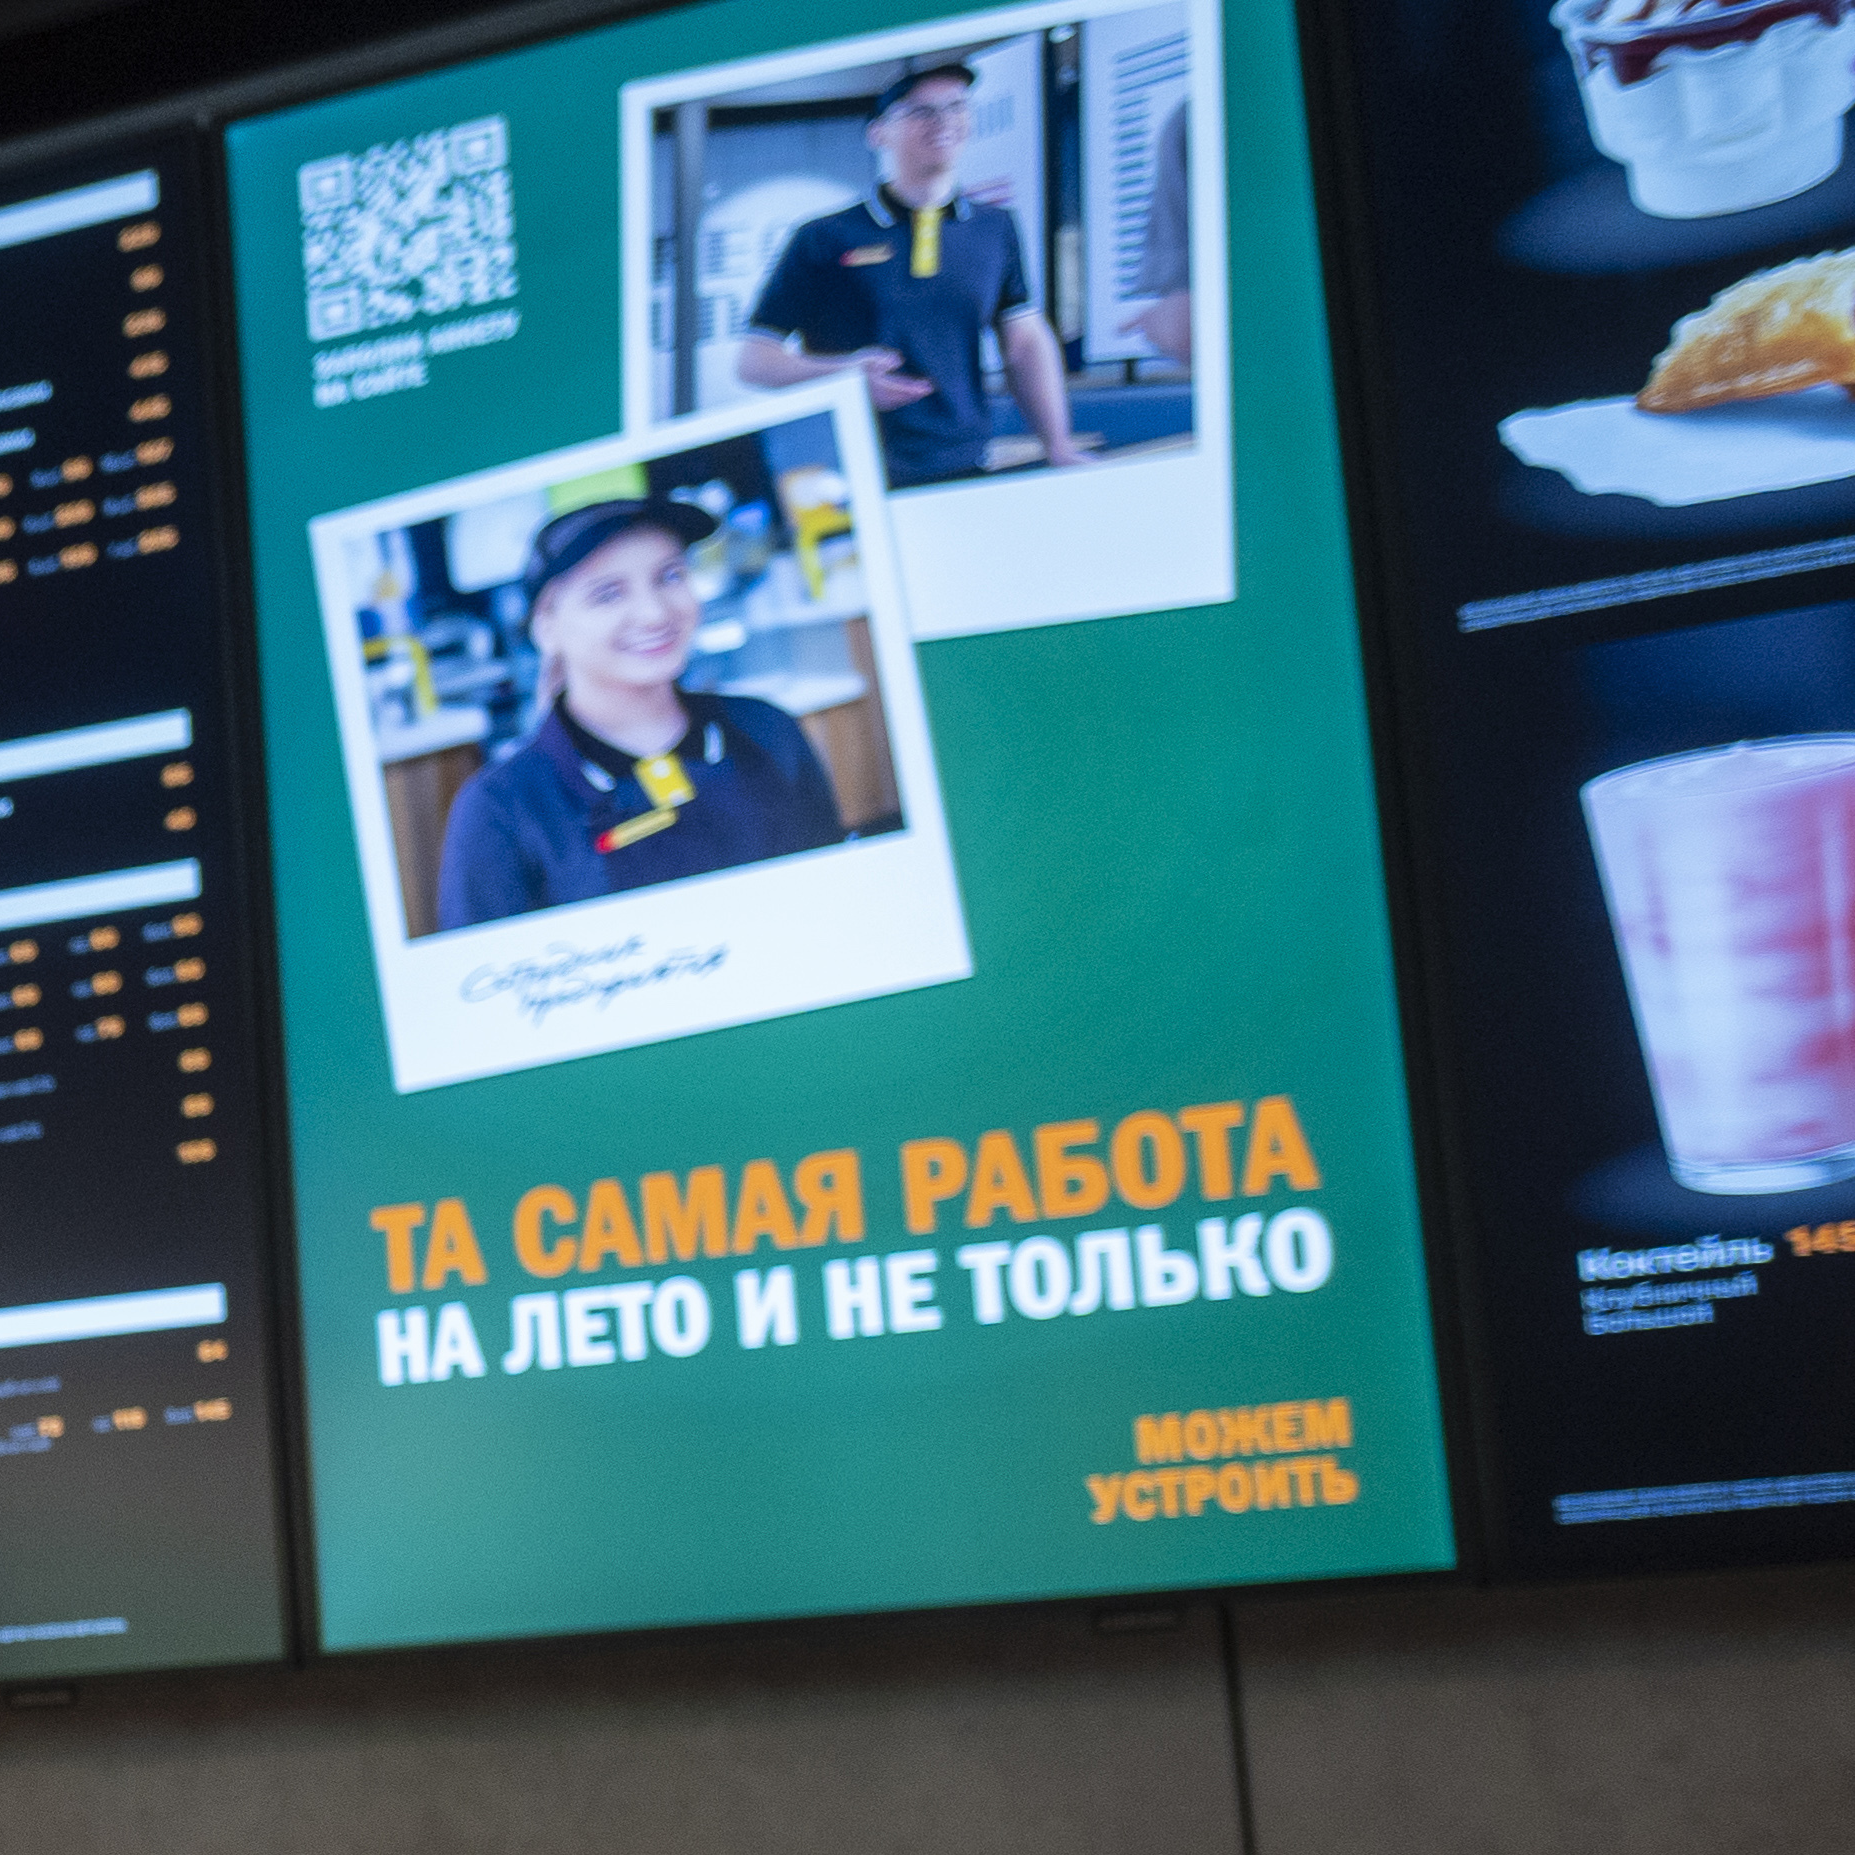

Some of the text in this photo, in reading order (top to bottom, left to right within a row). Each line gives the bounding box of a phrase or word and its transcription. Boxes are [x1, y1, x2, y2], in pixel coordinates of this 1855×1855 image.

[370, 1094, 1321, 1294] ТА САМАЯ РАБОТА
[1577, 1234, 1775, 1282] Коктейль
[376, 1205, 1335, 1387] НА ЛЕТО И НЕ ТОЛЬКО
[1134, 1397, 1352, 1464] МОЖЕМ
[1088, 1455, 1359, 1525] УСТРОИТЬ
